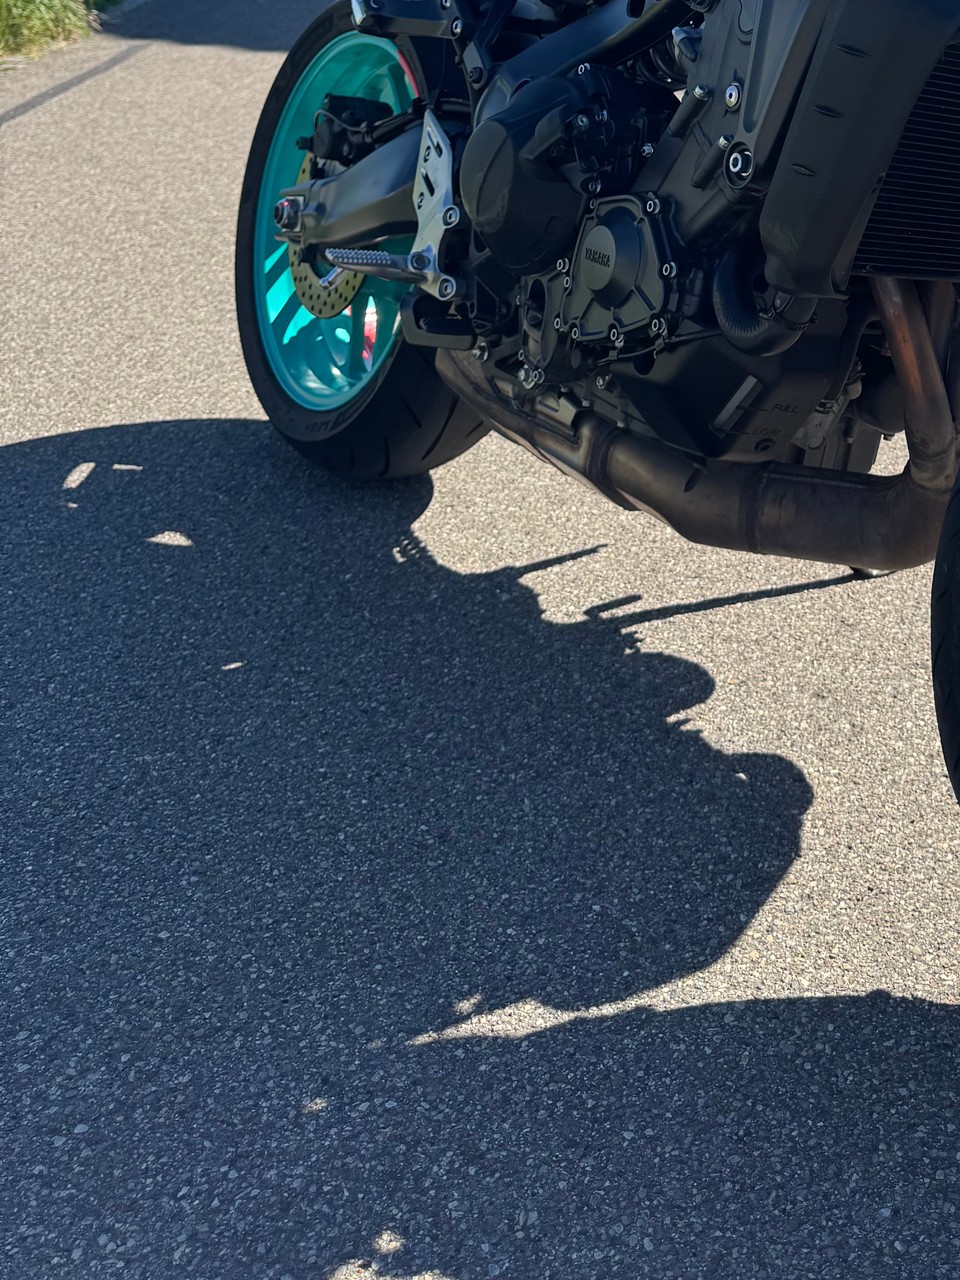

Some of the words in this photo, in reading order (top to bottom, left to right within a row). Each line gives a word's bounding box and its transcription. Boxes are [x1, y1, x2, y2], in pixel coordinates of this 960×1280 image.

[585, 247, 611, 268] YAMAHA
[770, 403, 799, 415] FULL
[752, 427, 783, 438] LOW
